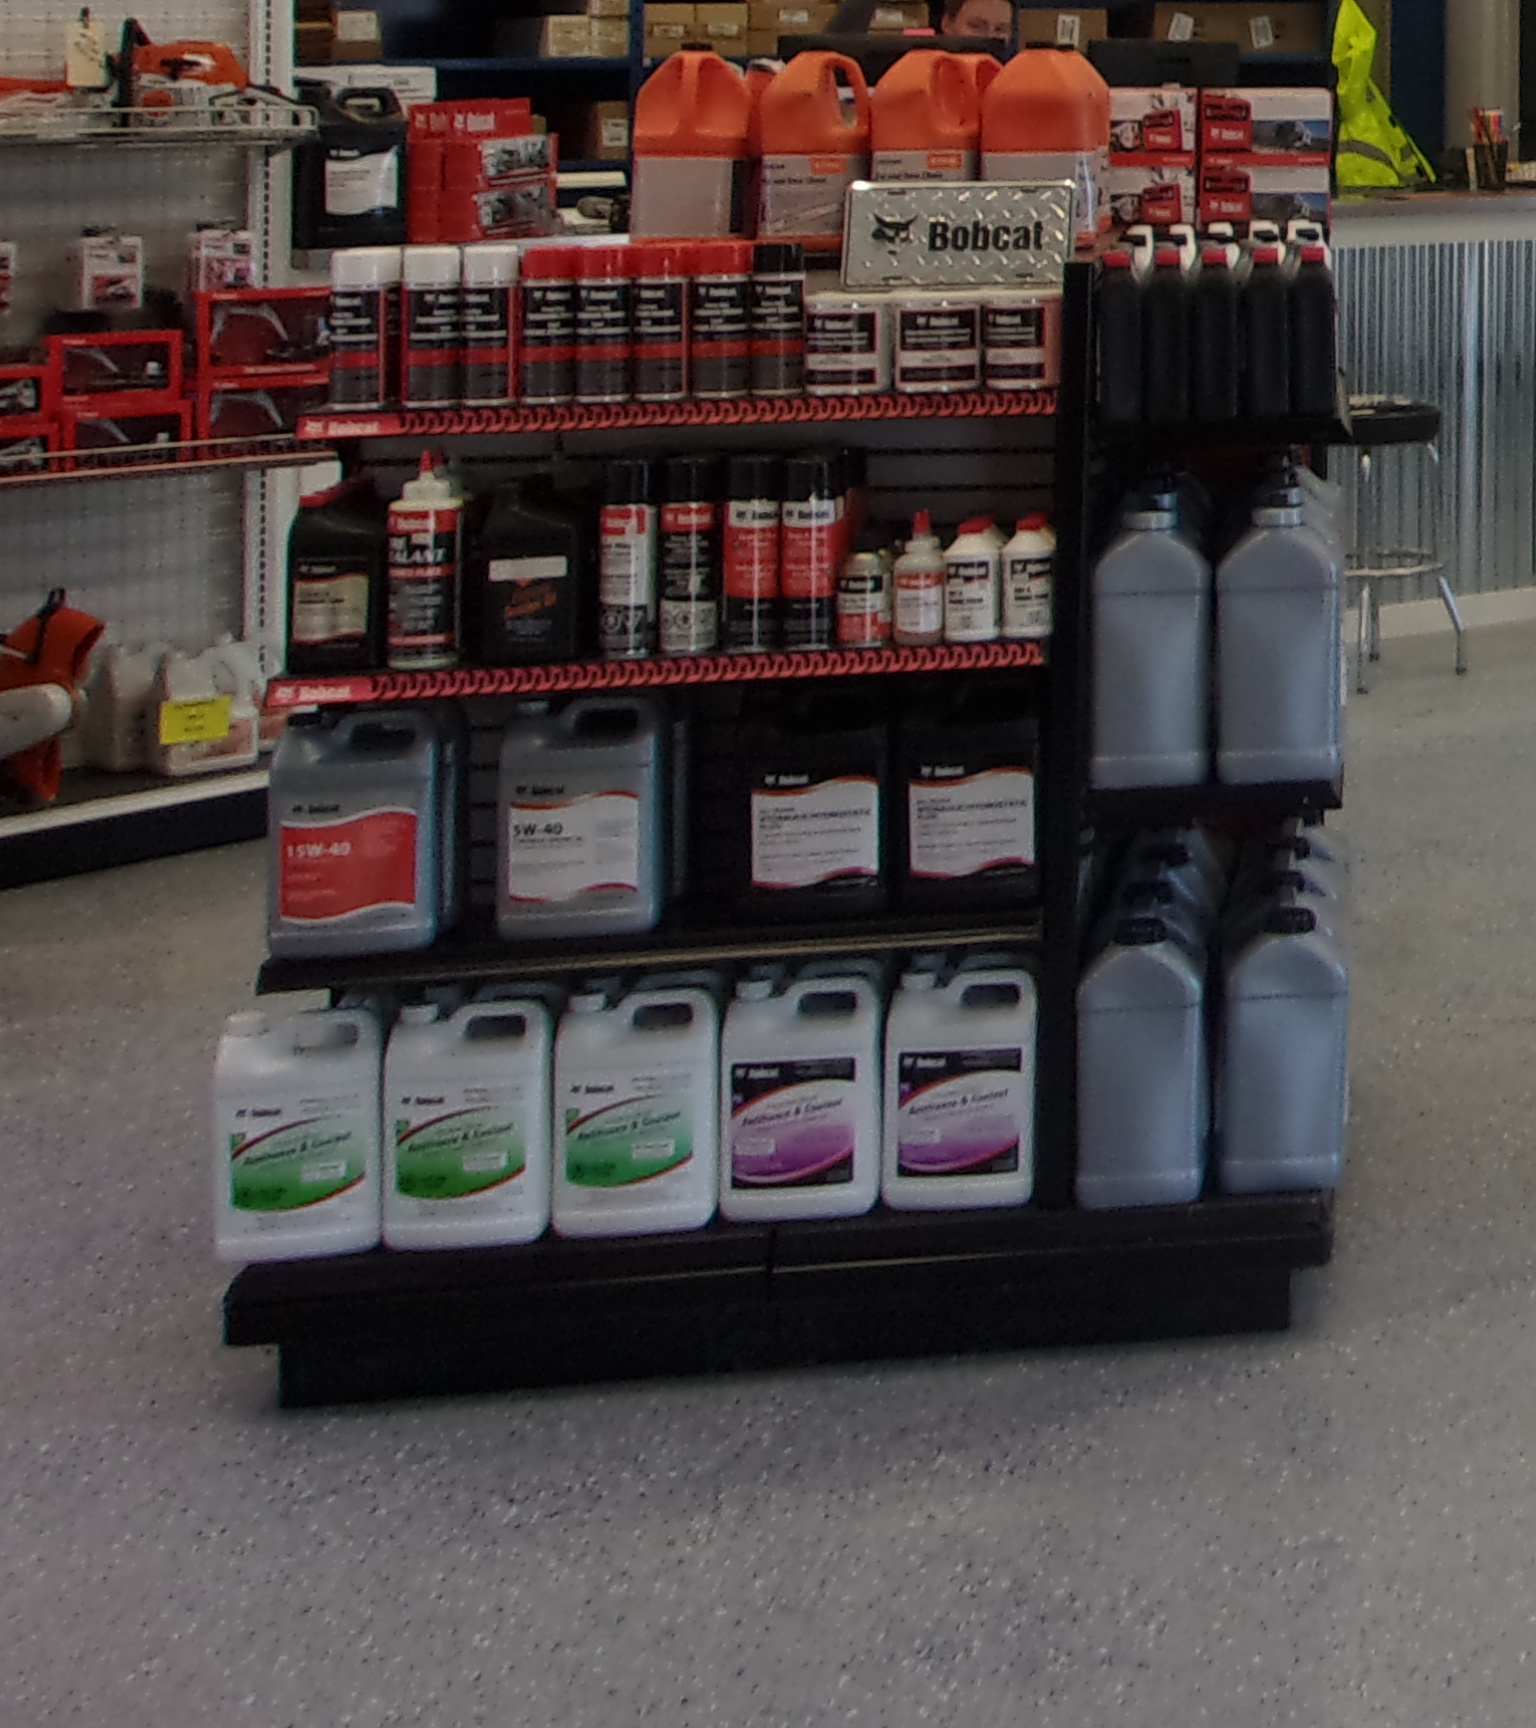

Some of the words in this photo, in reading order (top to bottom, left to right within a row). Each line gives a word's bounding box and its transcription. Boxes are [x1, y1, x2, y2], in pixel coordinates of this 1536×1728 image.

[927, 220, 1044, 252] Bobcat
[512, 821, 564, 837] 5W-40
[285, 840, 352, 859] 15W-40
